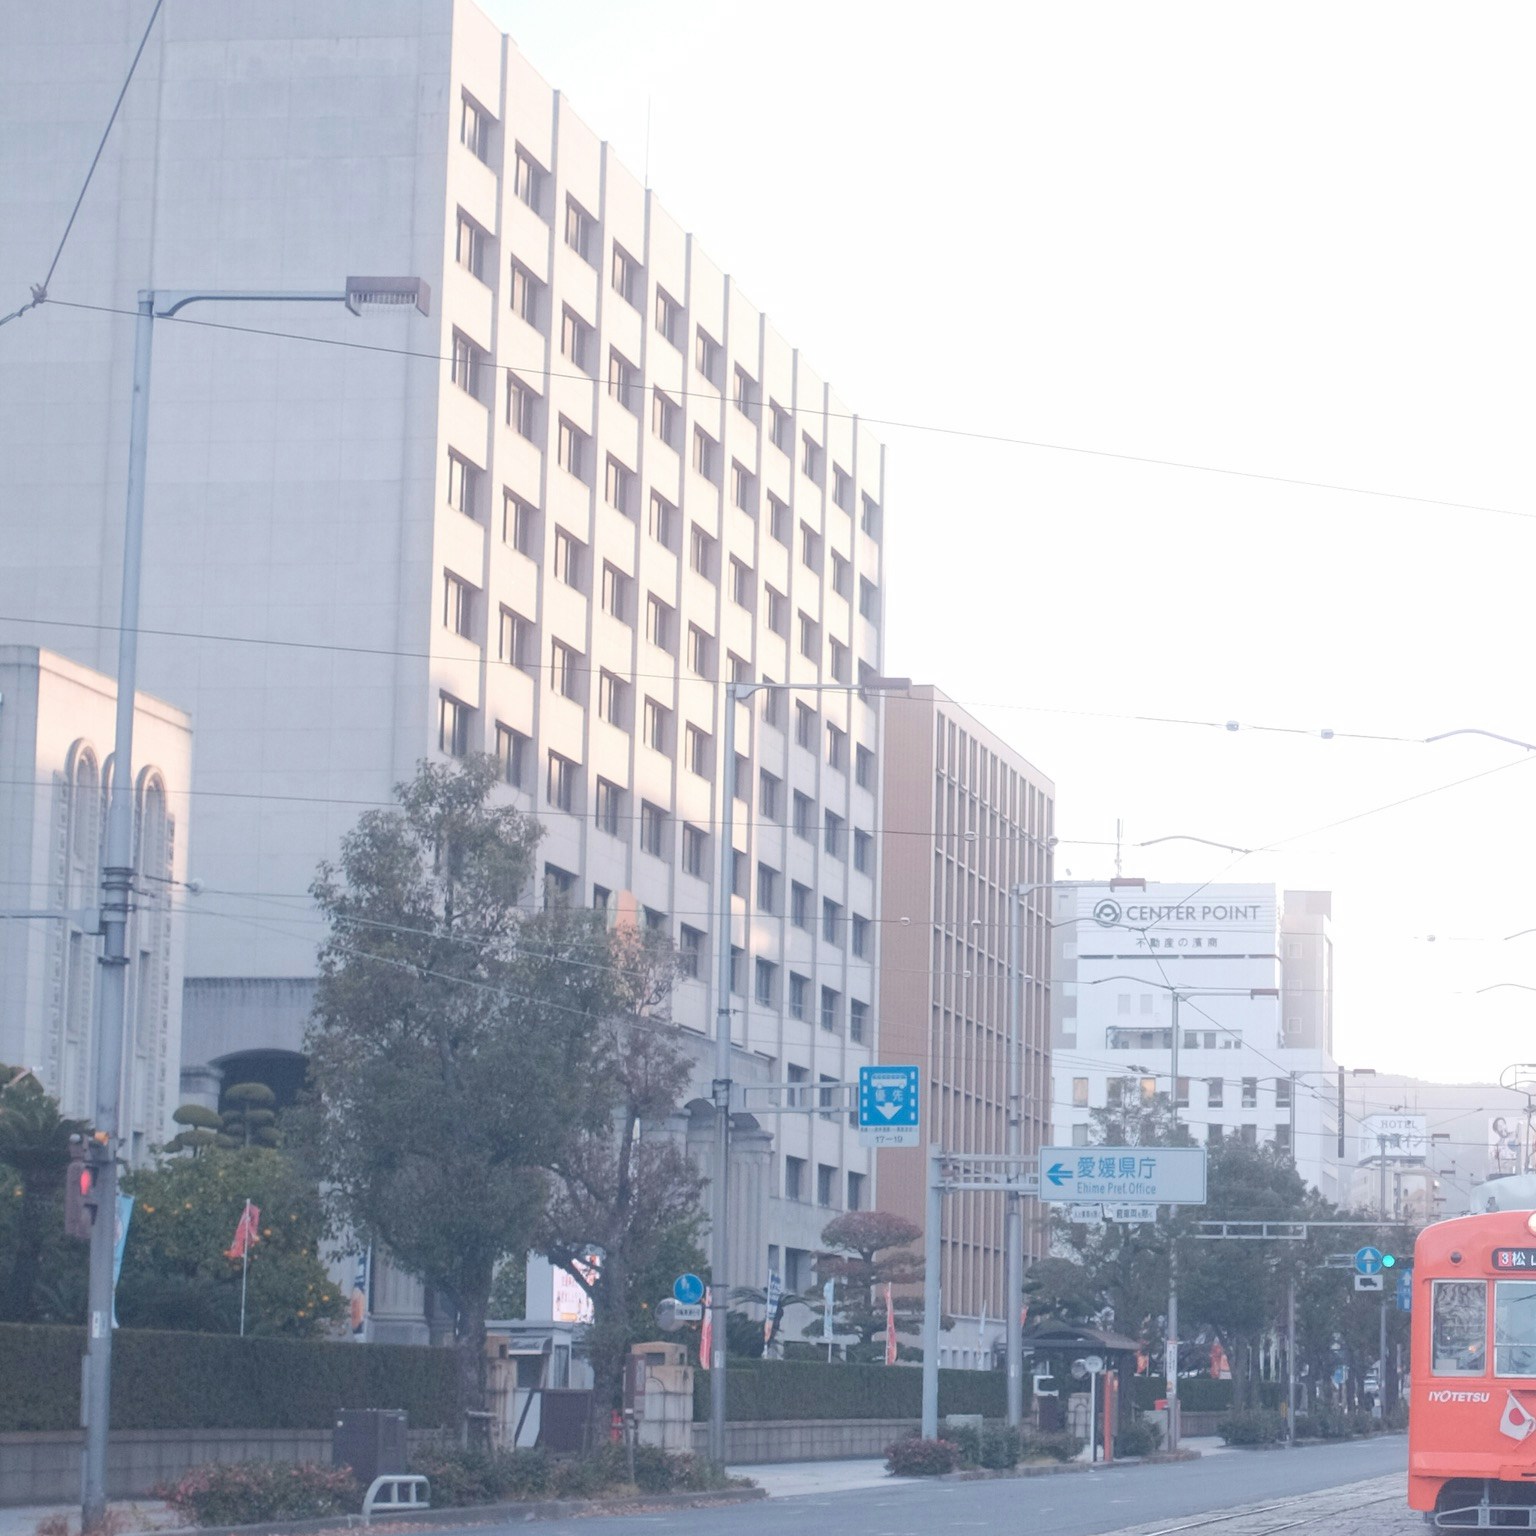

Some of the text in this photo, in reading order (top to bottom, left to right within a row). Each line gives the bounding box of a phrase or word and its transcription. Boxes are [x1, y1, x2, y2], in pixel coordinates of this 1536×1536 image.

[1126, 905, 1262, 921] CENTER POINT
[1077, 1156, 1157, 1179] 愛媛県庁
[1077, 1182, 1105, 1195] Ehime
[1501, 1252, 1509, 1265] 3
[1428, 1390, 1490, 1403] IYOTETSU
